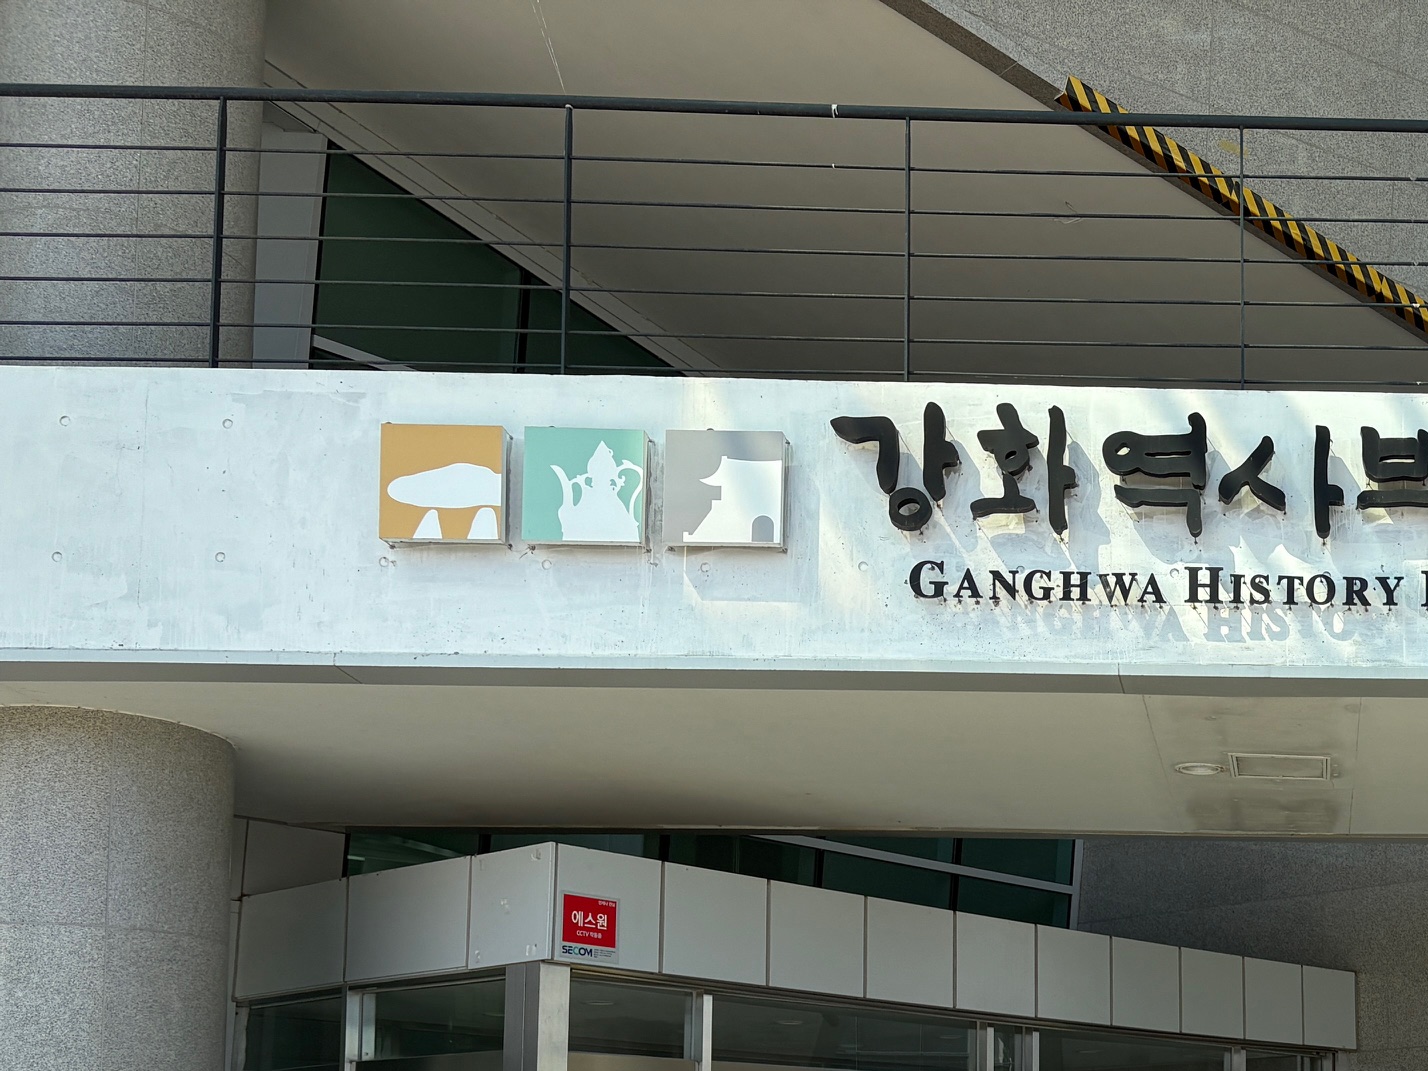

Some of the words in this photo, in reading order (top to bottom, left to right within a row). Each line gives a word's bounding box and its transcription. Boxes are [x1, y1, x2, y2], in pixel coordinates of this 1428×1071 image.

[908, 560, 1167, 604] GANGHWA
[1184, 566, 1405, 607] HISTORY
[571, 910, 608, 930] 에스원
[561, 945, 593, 957] SECOM
